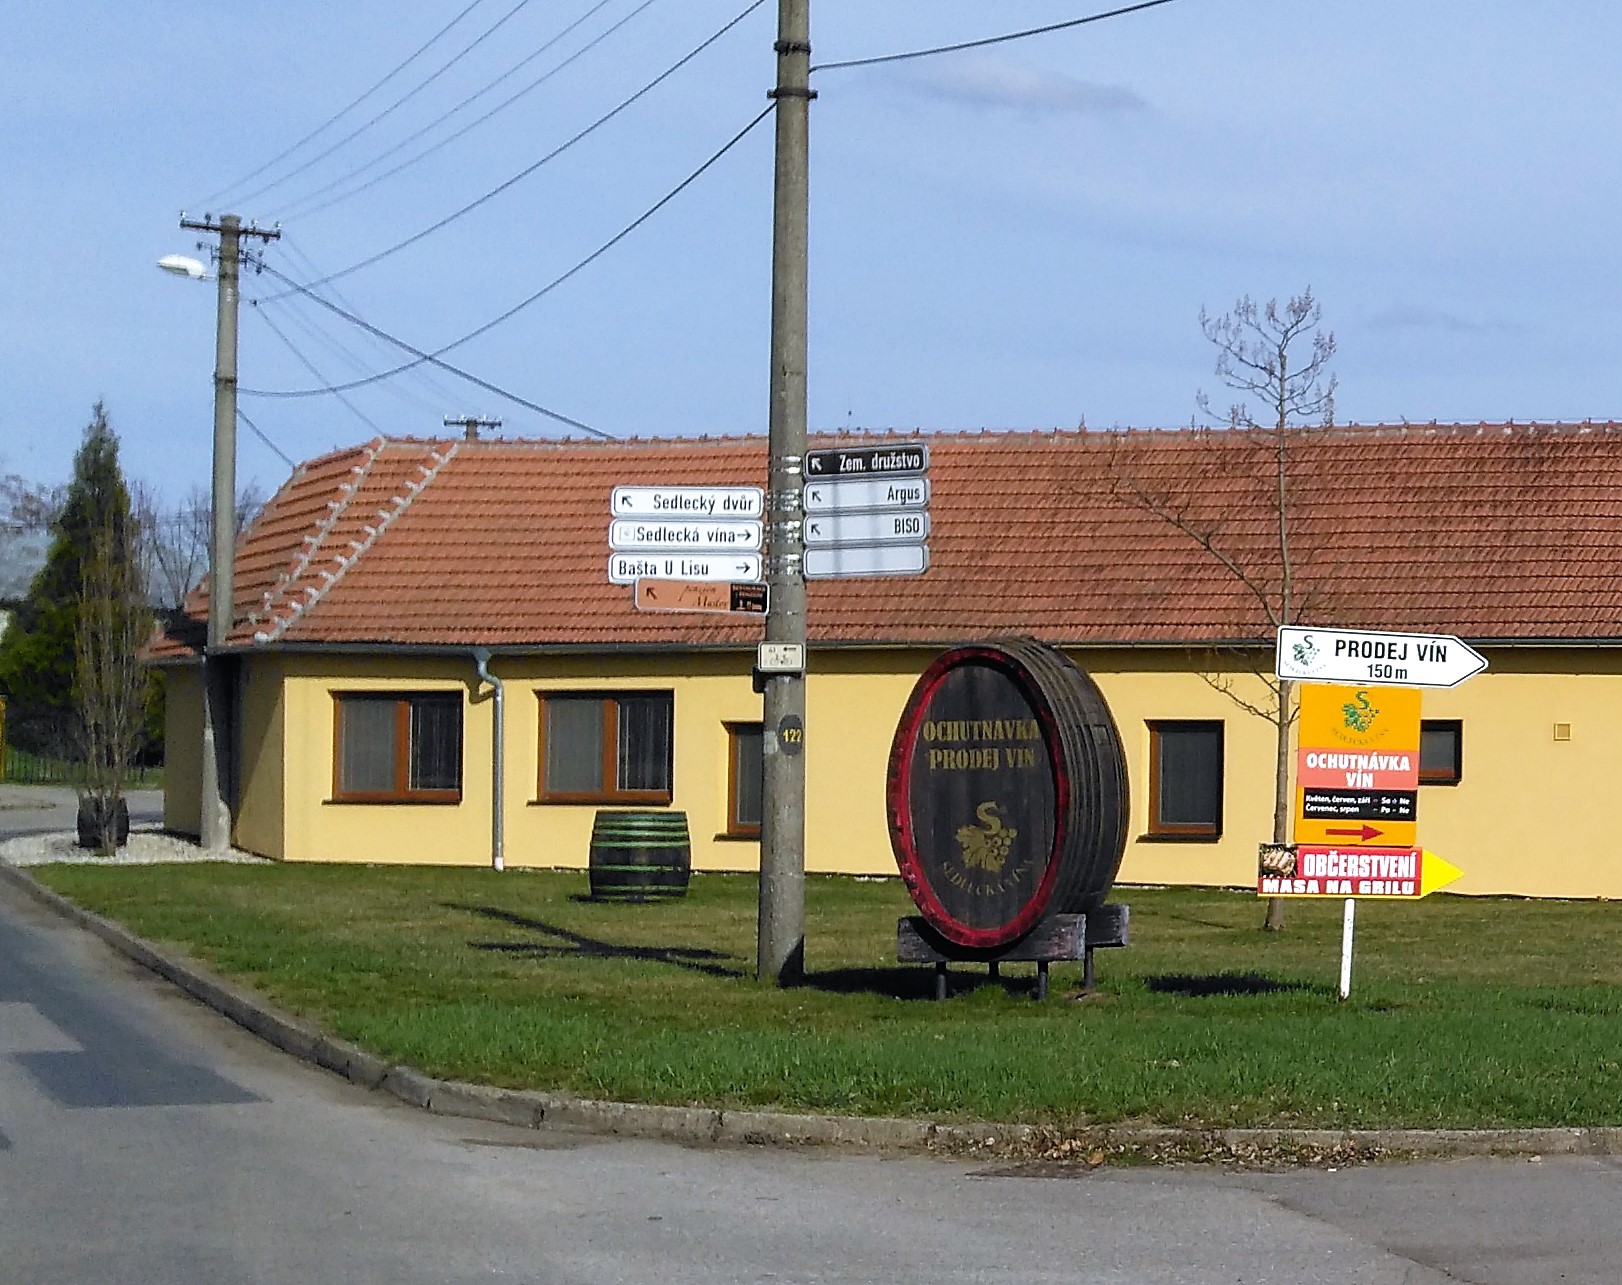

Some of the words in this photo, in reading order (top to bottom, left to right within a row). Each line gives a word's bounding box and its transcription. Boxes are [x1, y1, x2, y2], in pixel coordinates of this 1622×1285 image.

[839, 454, 866, 472] Zem.
[871, 452, 920, 470] družstvo
[653, 493, 716, 515] Sedlecký
[723, 494, 754, 511] dvůr
[887, 485, 921, 506] Argus
[636, 526, 700, 543] Sedlecká
[706, 526, 736, 543] vína
[894, 517, 921, 535] BISO
[618, 559, 657, 576] Bašta
[665, 560, 673, 576] U
[681, 560, 709, 576] Lisu
[1335, 638, 1408, 661] PRODEJ
[1416, 640, 1448, 663] VÍN
[929, 748, 999, 771] PRODEJ
[1306, 750, 1411, 771] OCHUTNÁVKA
[1345, 768, 1374, 788] VÍN
[1339, 805, 1360, 814] srpen
[1303, 850, 1417, 878] OBČERSTVENÍ
[1262, 878, 1320, 894] MASA
[1326, 879, 1352, 895] NA
[1359, 880, 1415, 895] GRILU
